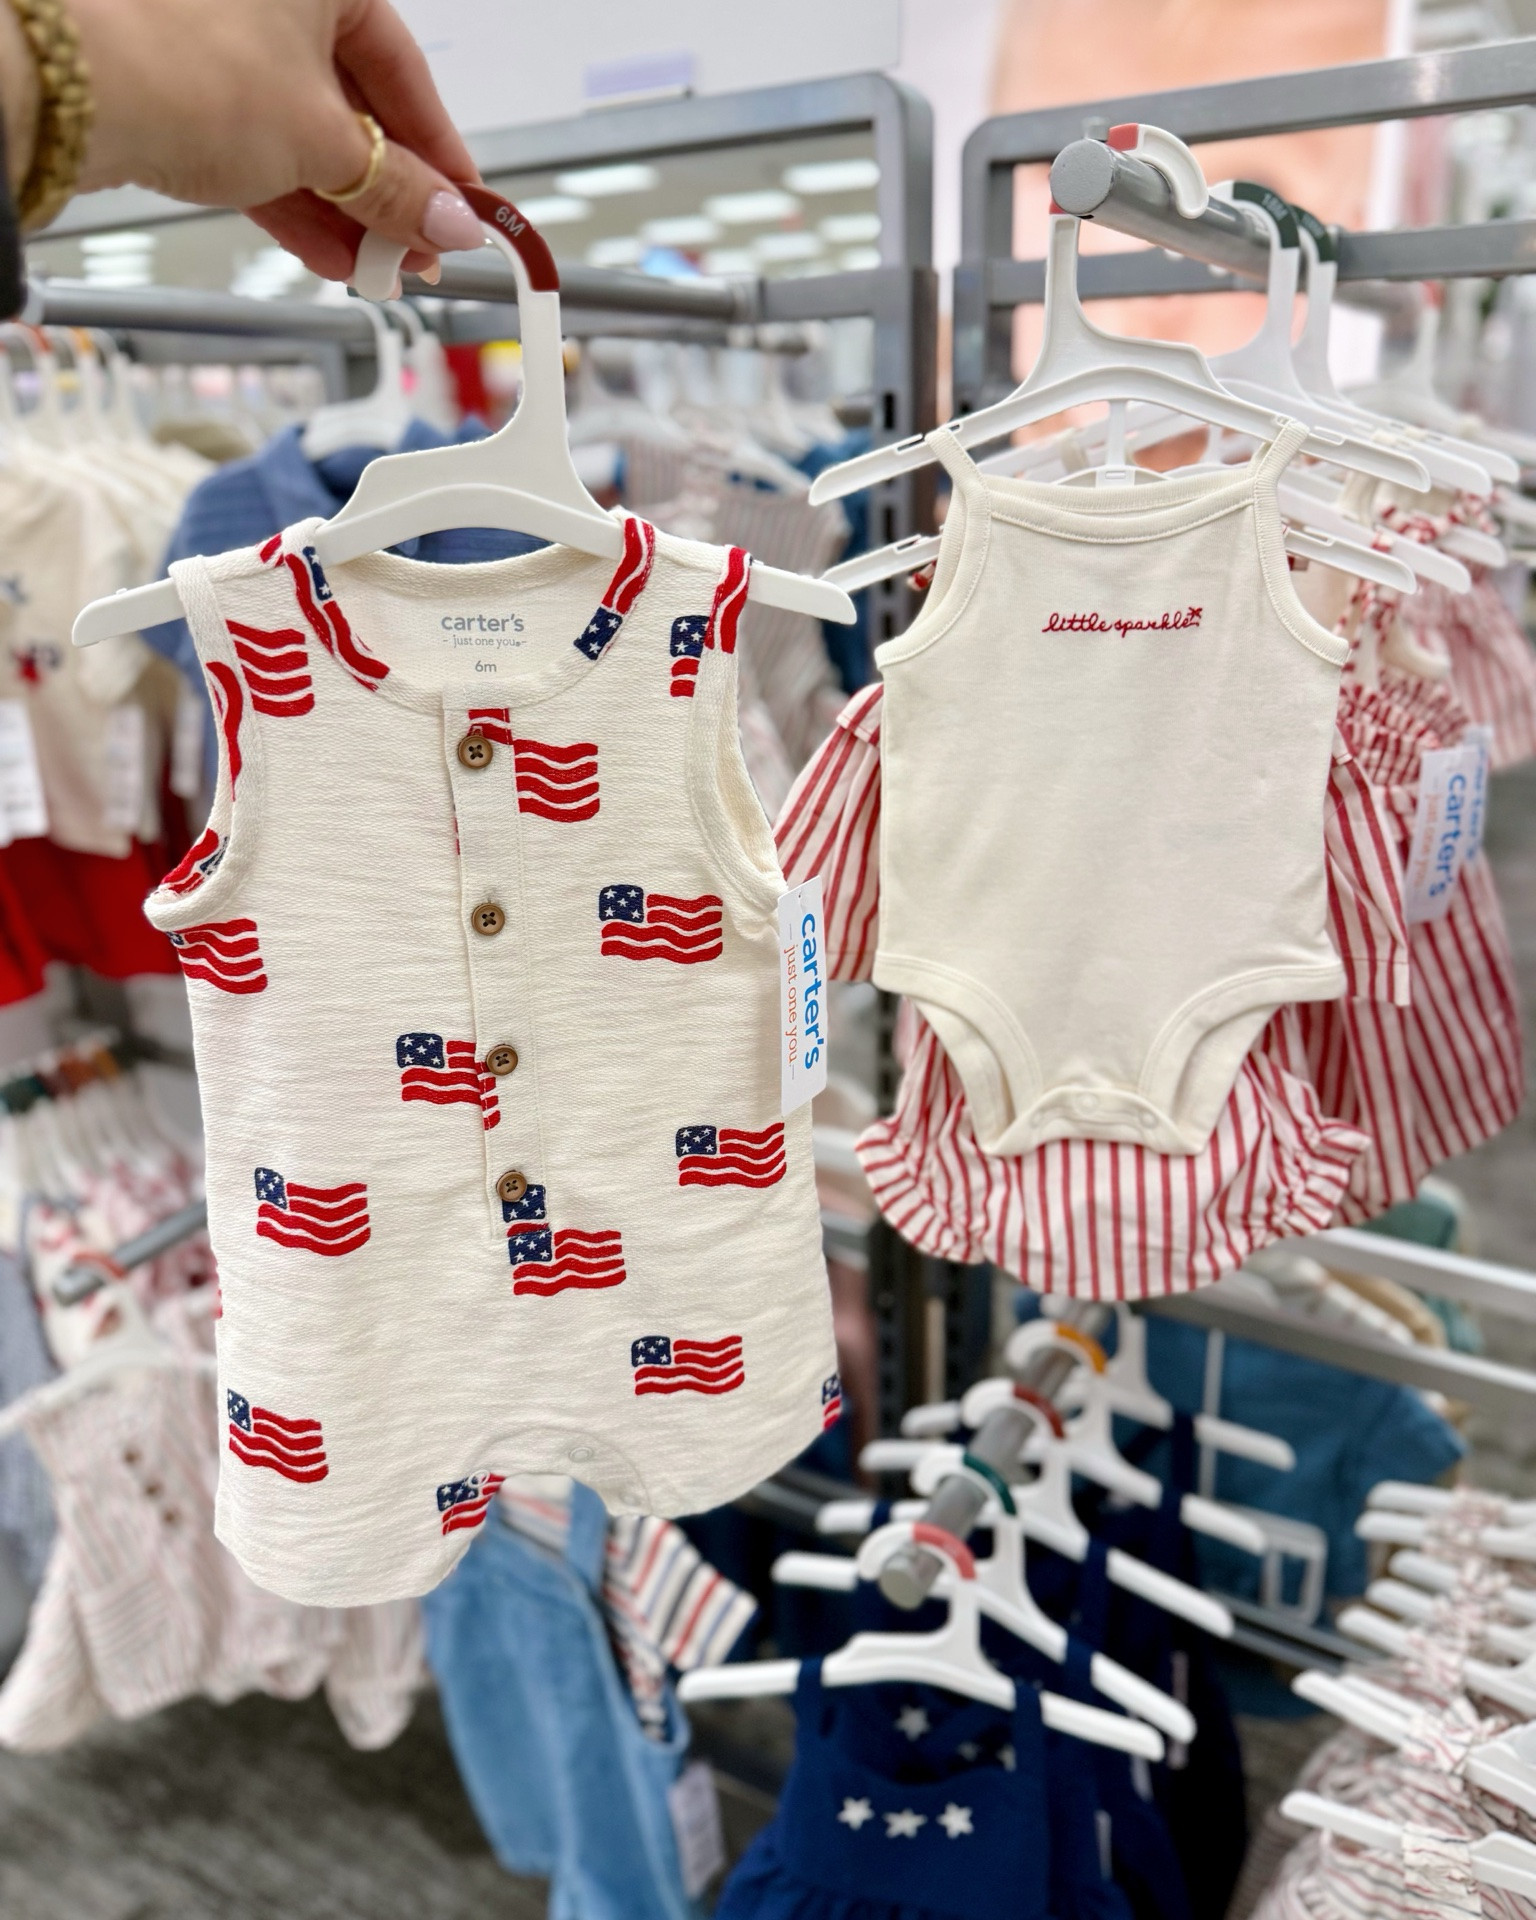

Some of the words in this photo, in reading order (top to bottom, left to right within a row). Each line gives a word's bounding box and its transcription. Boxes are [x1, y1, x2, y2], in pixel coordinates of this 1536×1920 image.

[495, 205, 527, 238] 6M
[441, 613, 525, 632] carter's
[1041, 612, 1113, 633] little
[1113, 611, 1200, 639] sparkle
[452, 634, 474, 648] just
[474, 637, 495, 646] one
[474, 660, 497, 673] 6m
[1428, 773, 1467, 897] carter's
[783, 943, 799, 982] just
[787, 986, 798, 1024] one
[801, 912, 825, 1071] carter's
